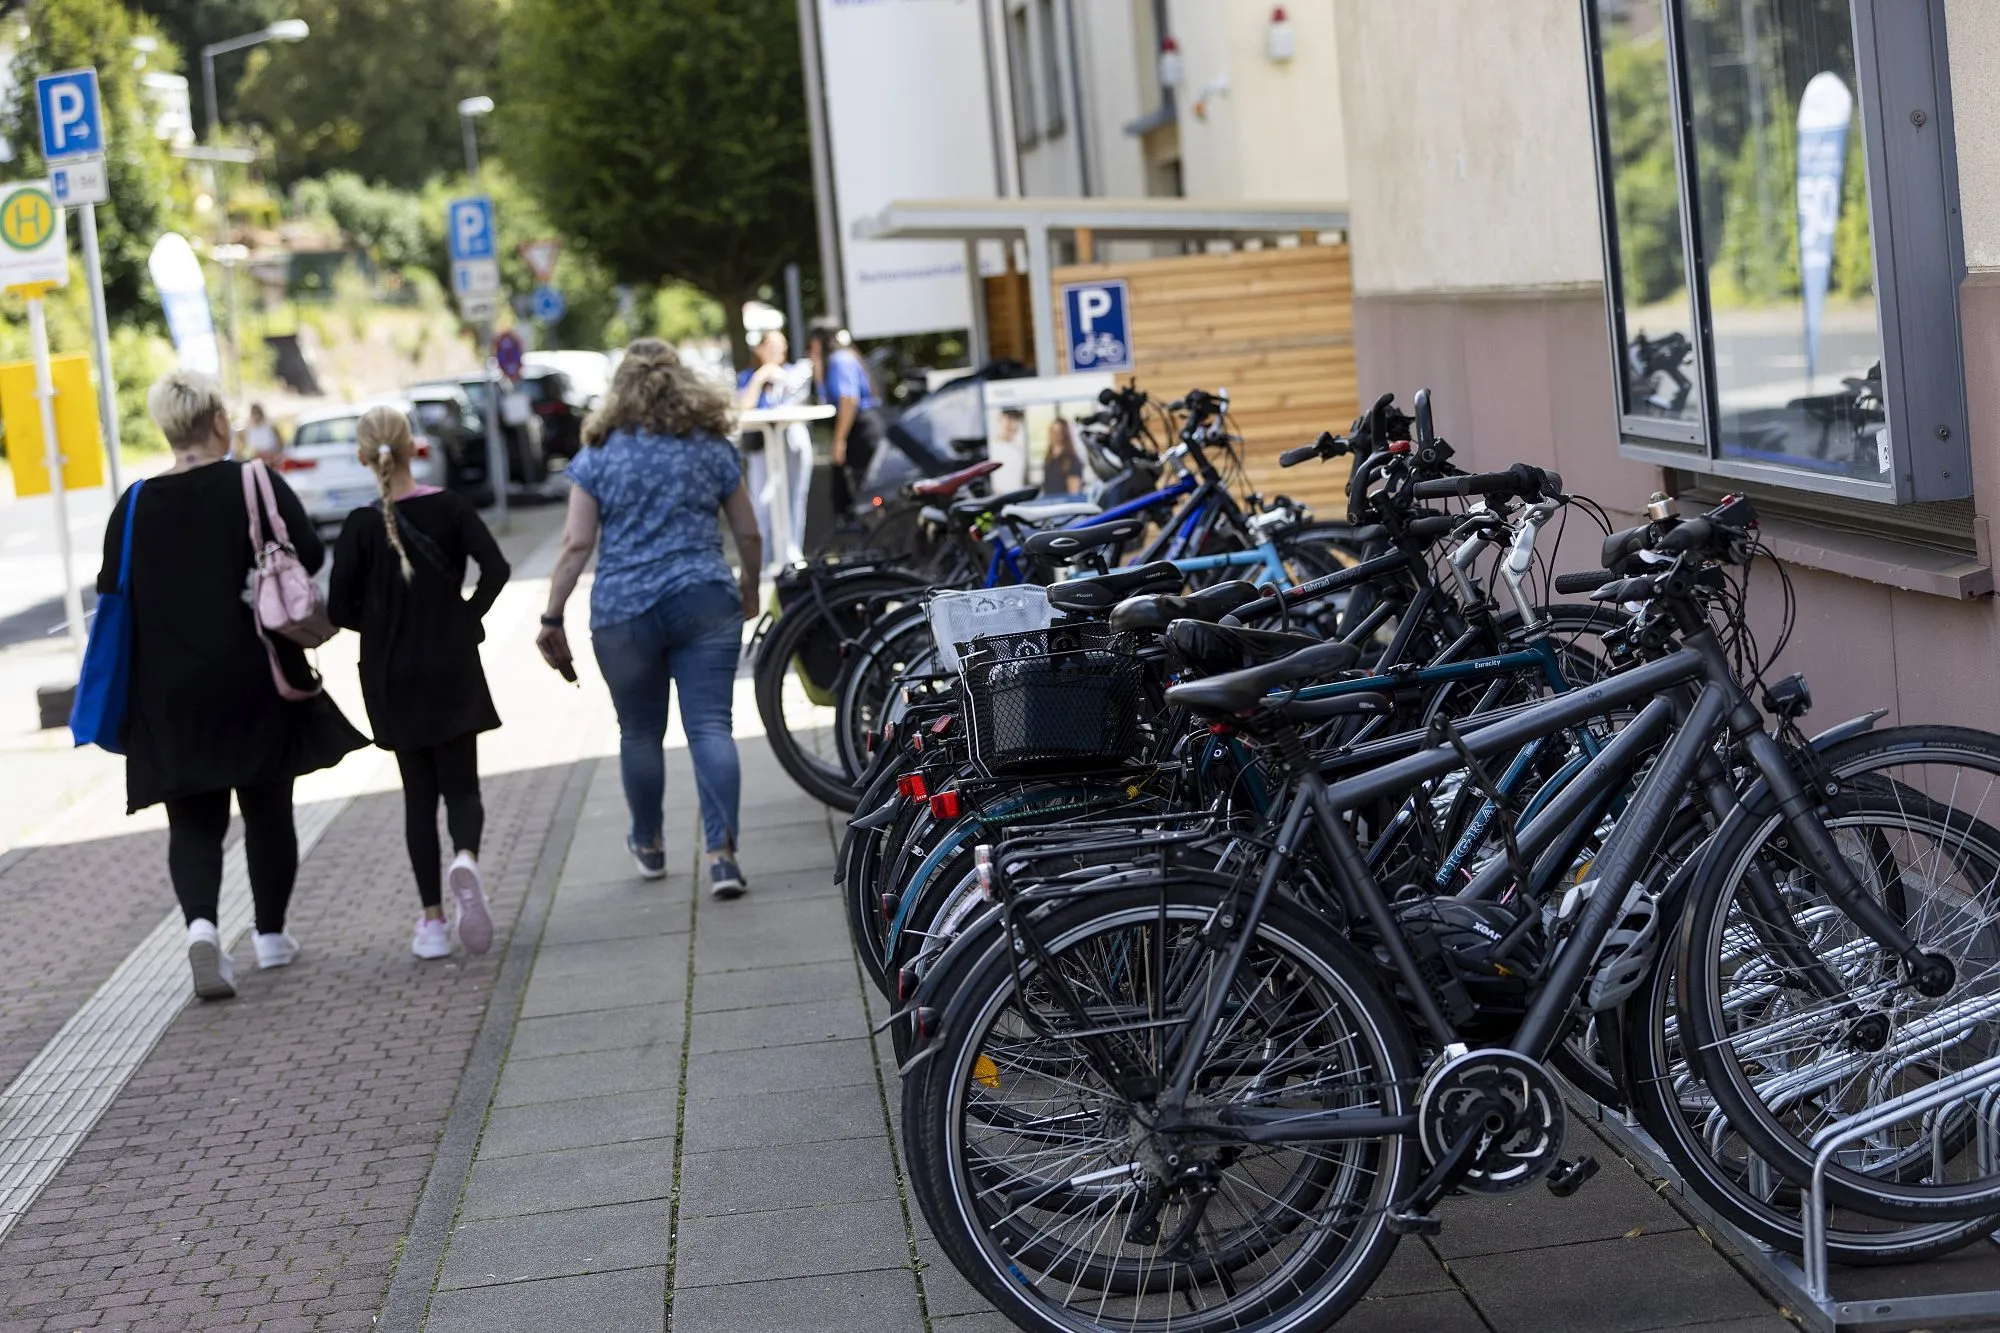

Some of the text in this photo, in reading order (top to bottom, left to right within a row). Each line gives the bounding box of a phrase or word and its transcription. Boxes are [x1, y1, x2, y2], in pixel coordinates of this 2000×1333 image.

[49, 83, 85, 149] P
[16, 202, 40, 239] H
[457, 204, 485, 255] P
[1078, 288, 1112, 334] P
[1474, 660, 1501, 669] Eurocity
[1436, 805, 1497, 885] TIGRA
